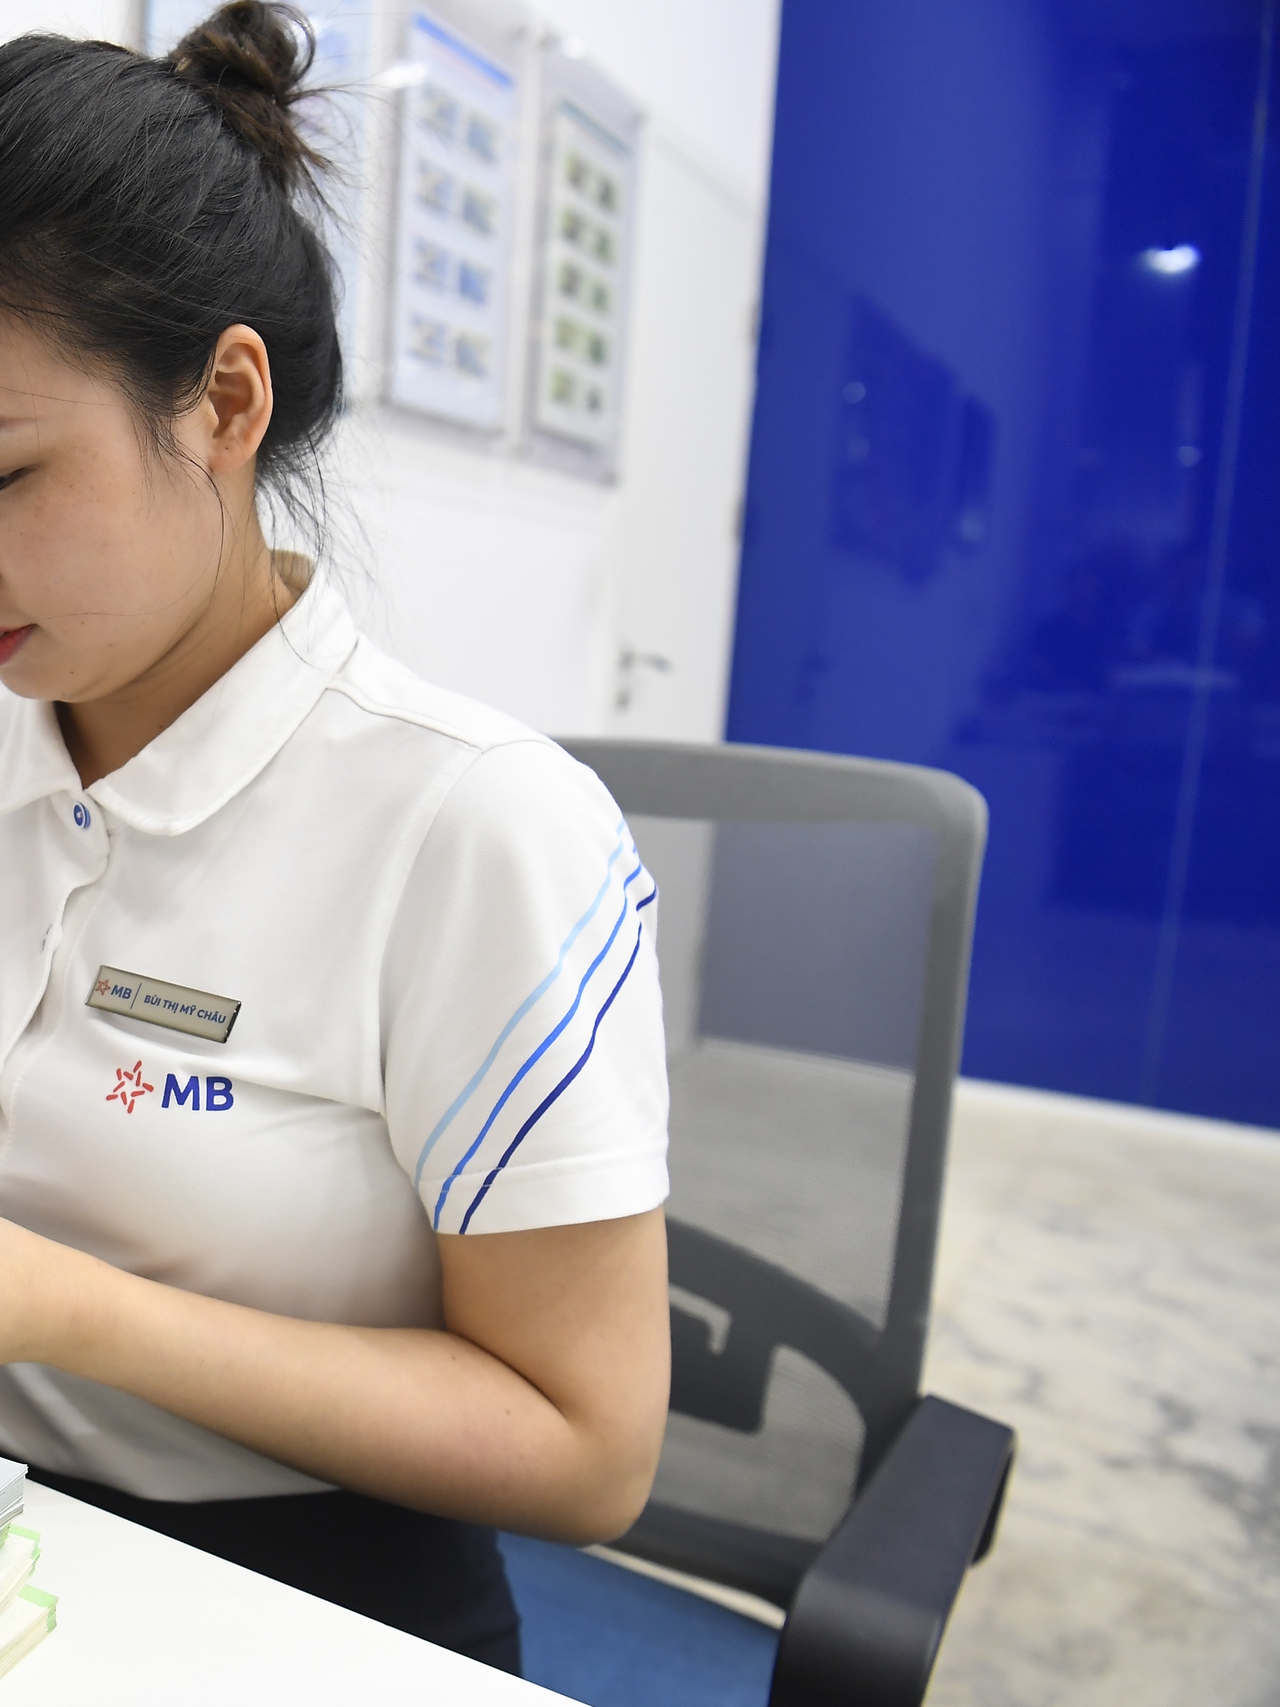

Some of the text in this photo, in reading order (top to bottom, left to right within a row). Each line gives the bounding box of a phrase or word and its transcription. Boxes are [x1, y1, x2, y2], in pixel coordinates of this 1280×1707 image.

[111, 985, 132, 999] MB
[163, 1000, 179, 1013] THỊ
[180, 1004, 196, 1016] MỸ
[197, 1010, 227, 1024] CHÂU
[161, 1073, 234, 1112] MB
